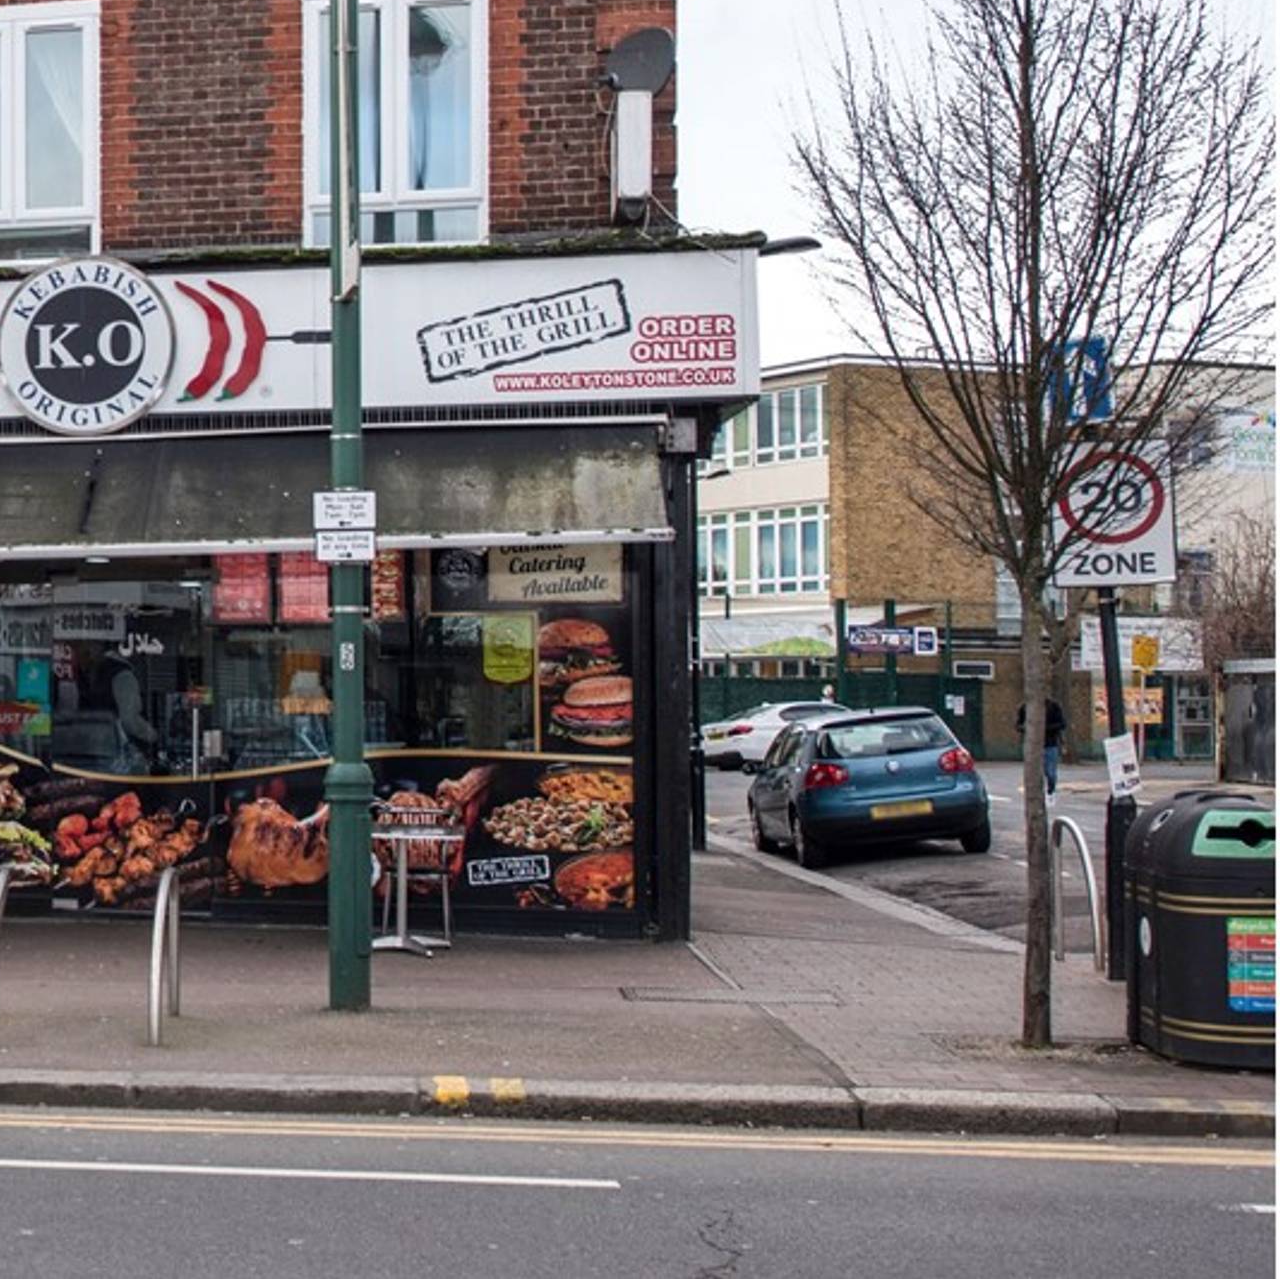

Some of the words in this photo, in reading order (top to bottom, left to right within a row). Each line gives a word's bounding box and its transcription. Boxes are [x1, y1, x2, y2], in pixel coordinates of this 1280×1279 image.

[13, 264, 159, 321] KEBABISH
[441, 321, 494, 348] THE
[501, 295, 600, 333] THRILL
[641, 316, 735, 337] ORDER
[32, 320, 144, 370] K.O
[437, 349, 467, 370] OF
[474, 333, 527, 360] THE
[537, 311, 617, 345] GRILL
[632, 339, 735, 361] ONLINE
[495, 369, 734, 392] WWW.KOLEYTONSTONE.CO.UK
[18, 374, 159, 427] ORIGINAL
[1079, 481, 1143, 512] 20
[507, 554, 586, 574] Catering
[1073, 552, 1157, 576] ZONE
[521, 574, 609, 598] Available
[118, 633, 164, 657] حلال
